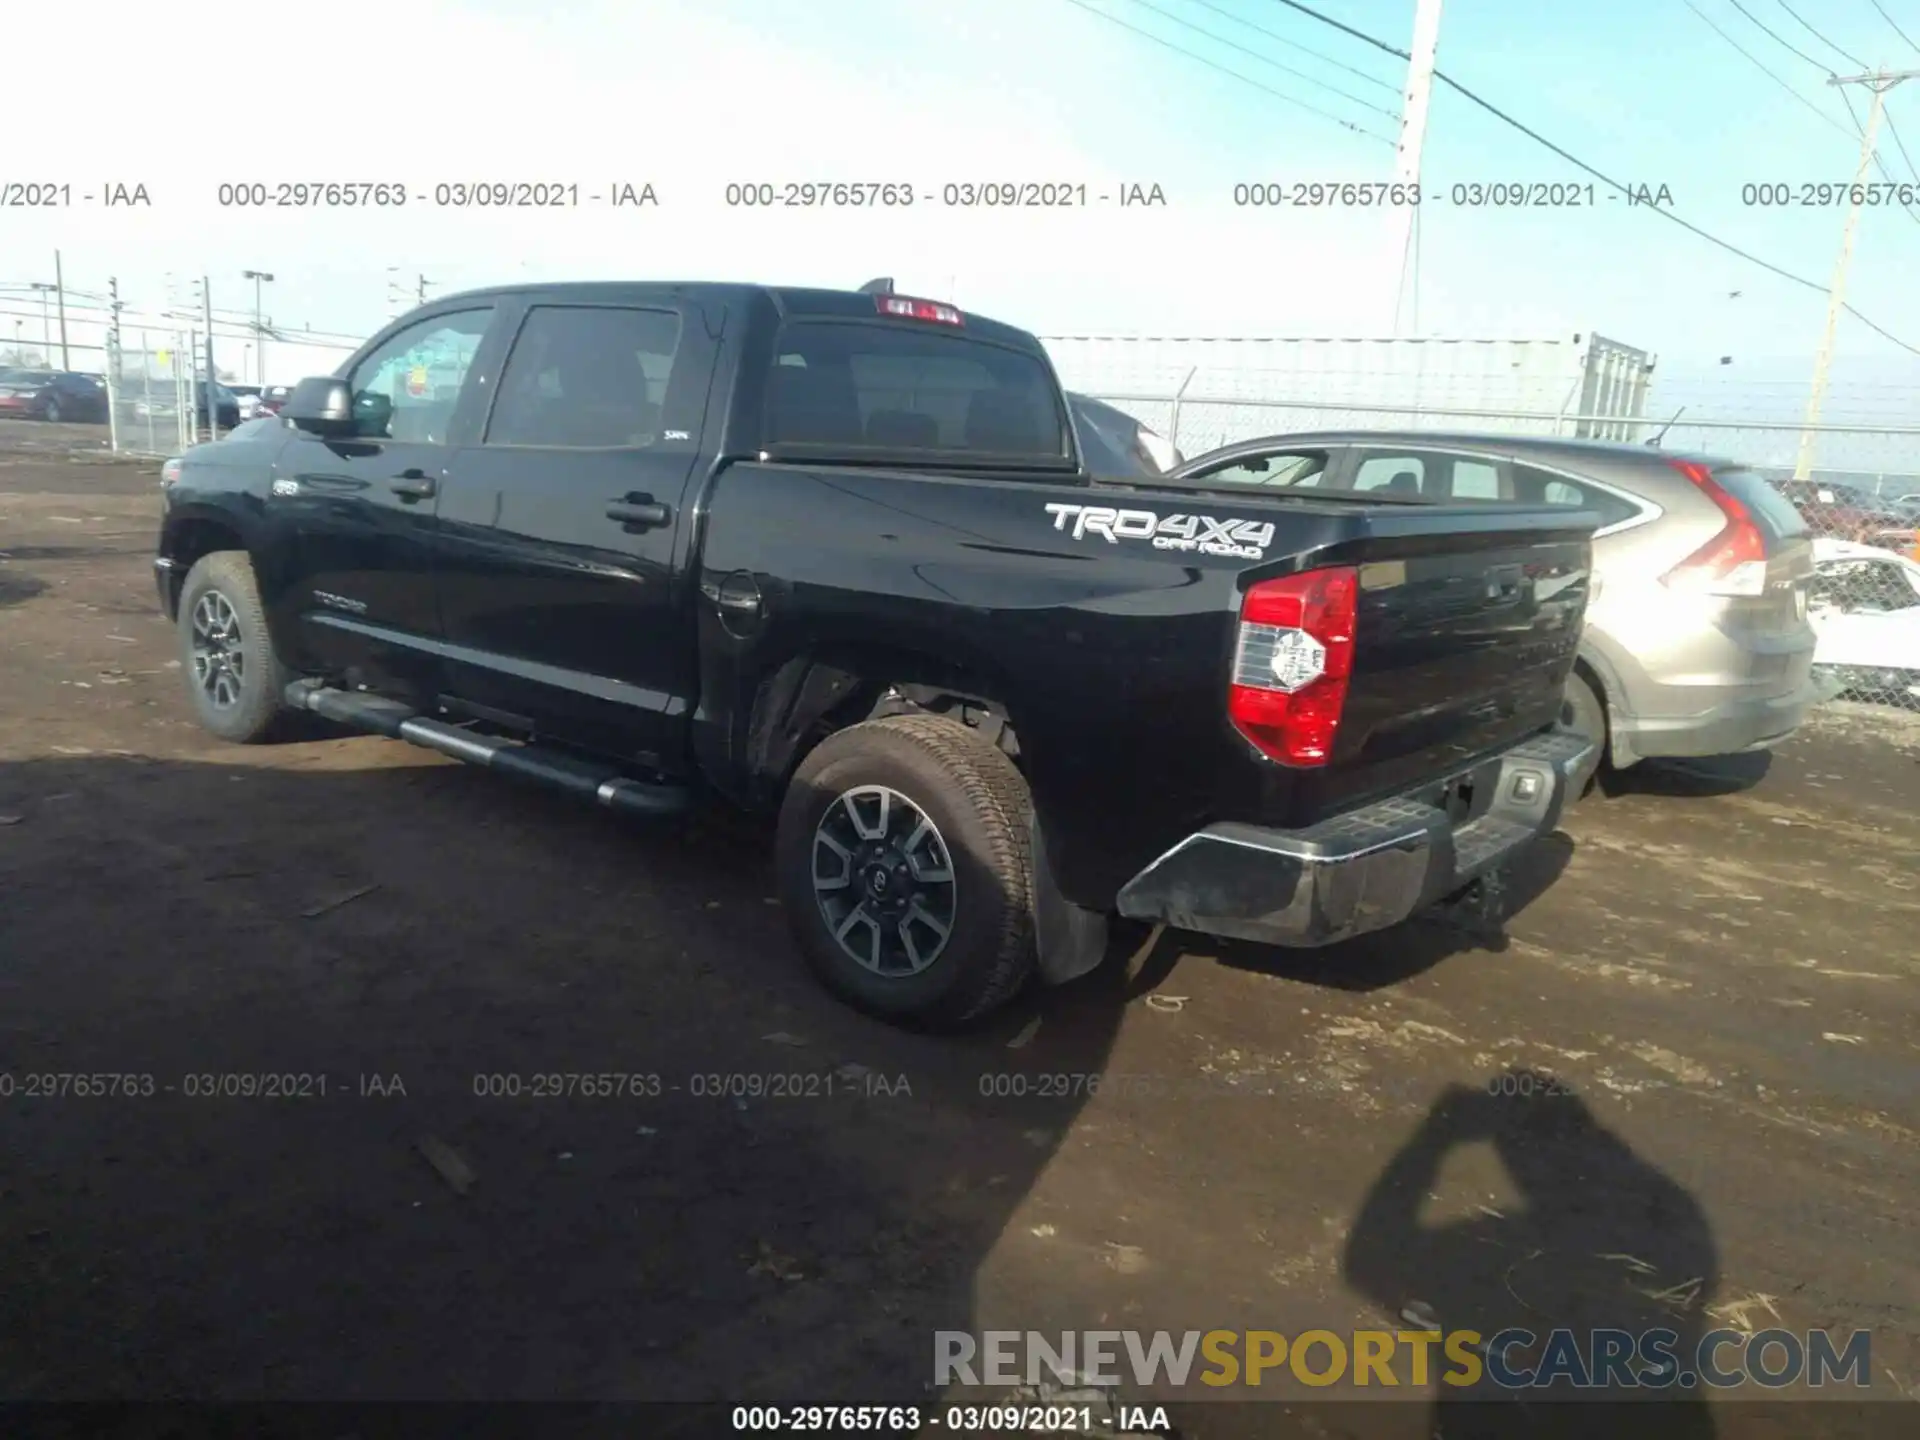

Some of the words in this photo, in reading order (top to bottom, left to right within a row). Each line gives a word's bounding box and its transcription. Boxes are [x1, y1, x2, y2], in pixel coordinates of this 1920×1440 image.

[1044, 502, 1157, 544] TRD
[1152, 536, 1197, 551] OFF
[1197, 542, 1263, 560] ROAD
